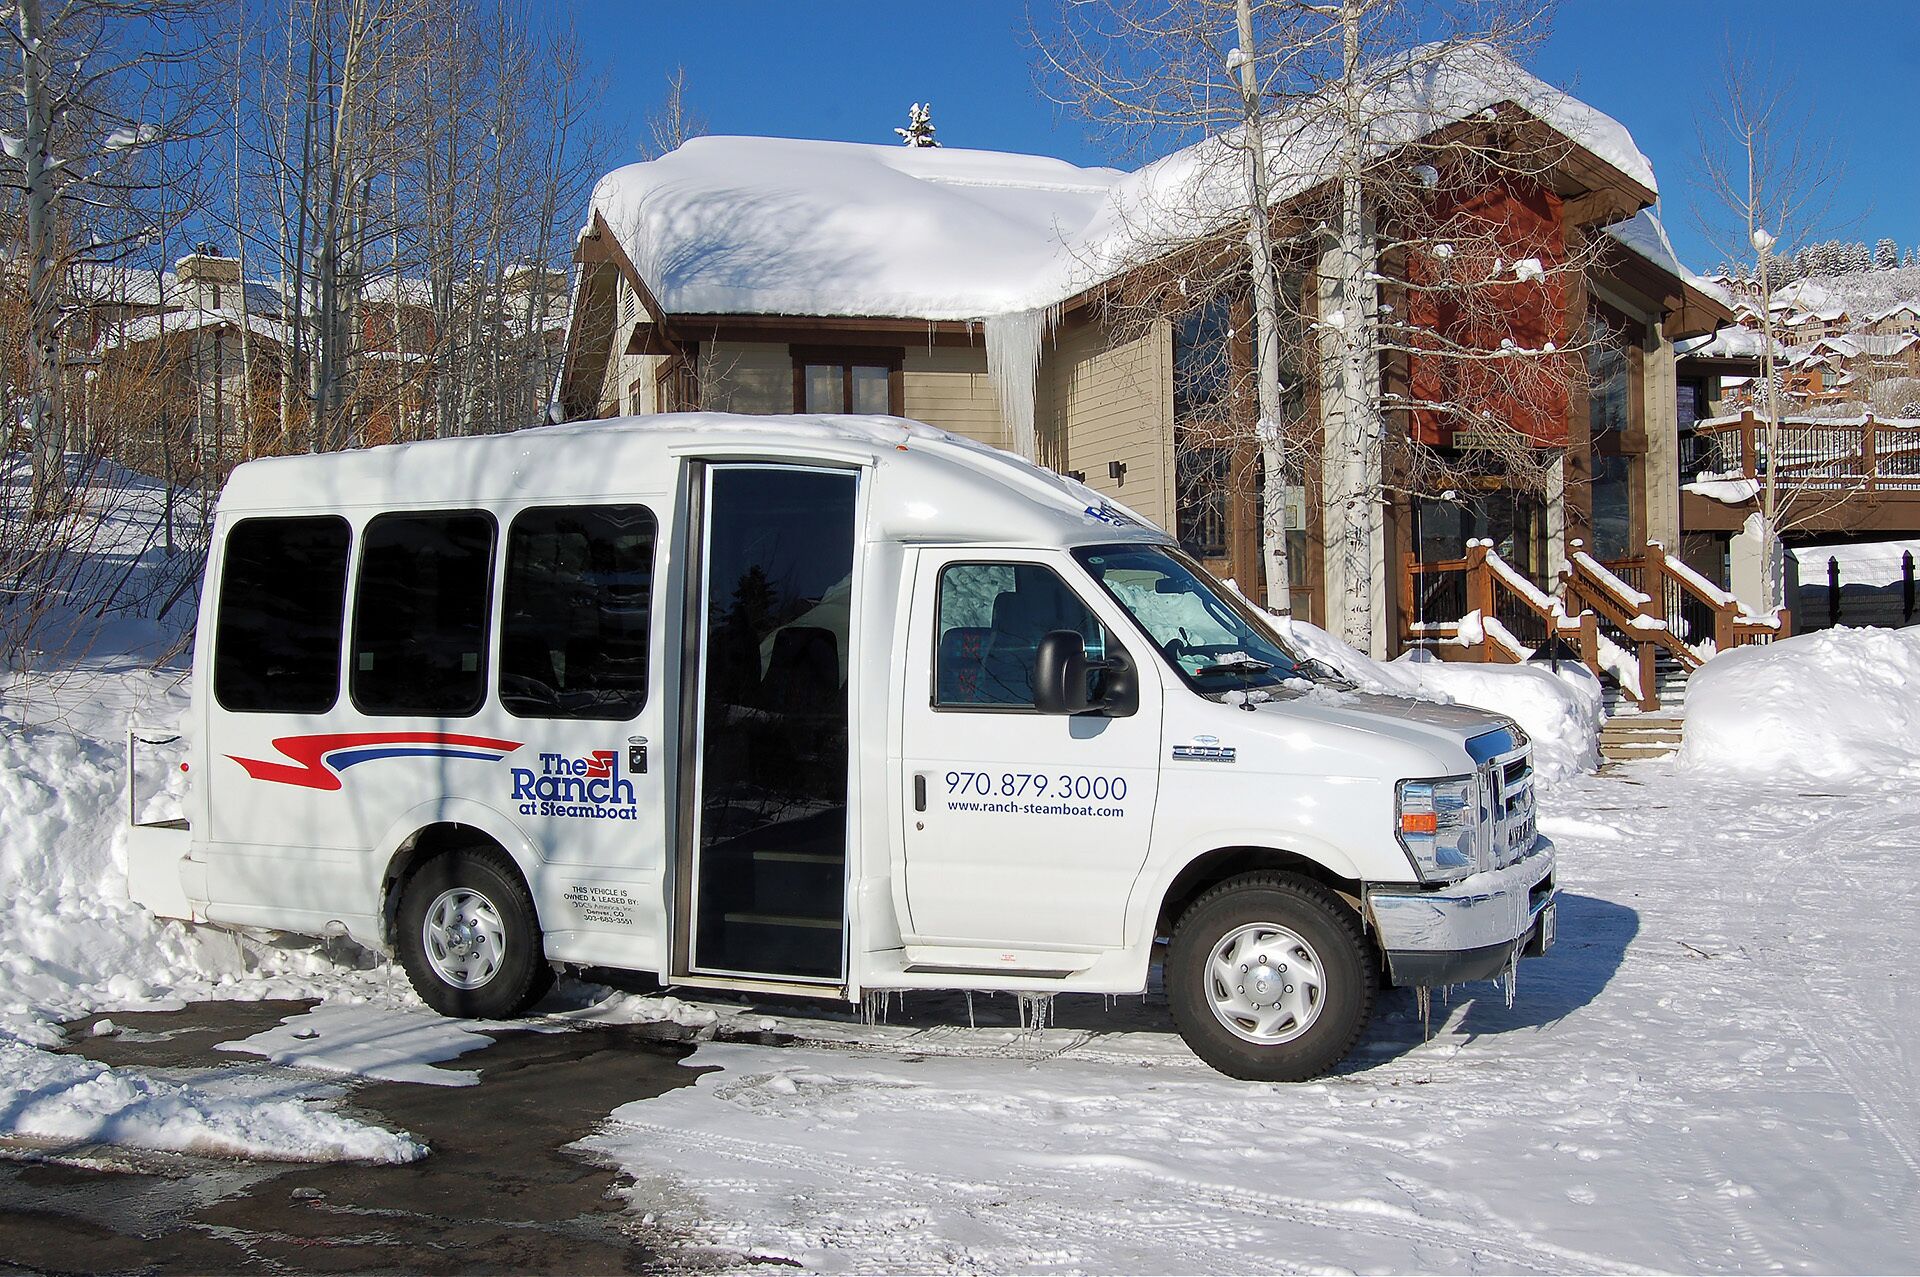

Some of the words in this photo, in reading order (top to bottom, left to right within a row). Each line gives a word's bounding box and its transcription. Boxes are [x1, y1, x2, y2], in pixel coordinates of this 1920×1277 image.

[539, 753, 588, 775] The
[511, 751, 636, 804] Ranch
[945, 771, 1127, 800] 970.879.3000
[519, 801, 538, 816] at
[540, 801, 637, 820] Steamboat
[947, 801, 1124, 817] www.ranch-steamboat.com
[563, 893, 588, 901] OWNED
[598, 896, 625, 904] LEASED
[589, 888, 618, 896] VEHICLE
